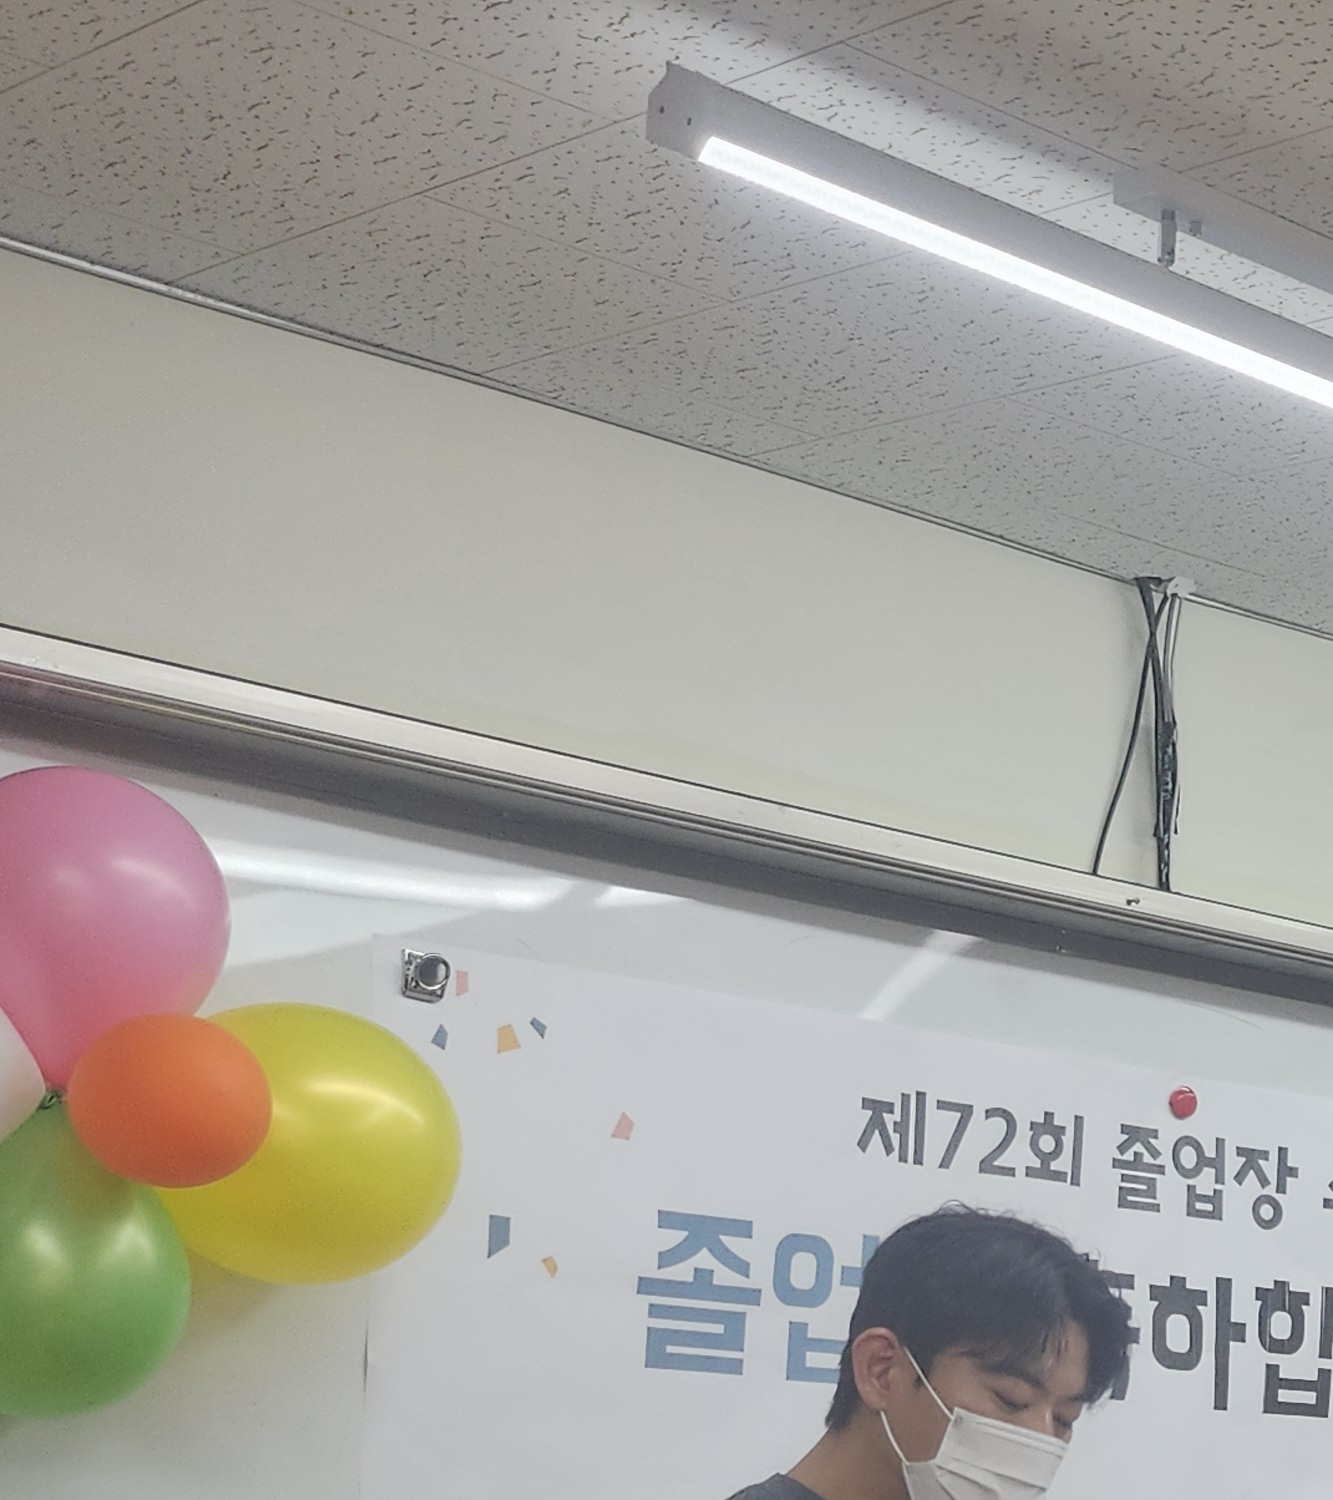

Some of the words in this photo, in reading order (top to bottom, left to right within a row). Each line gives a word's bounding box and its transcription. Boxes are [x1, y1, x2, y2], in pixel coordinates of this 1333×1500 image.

[856, 1090, 1084, 1187] 제72회
[1112, 1122, 1300, 1231] 졸업장
[637, 1209, 880, 1385] 졸업
